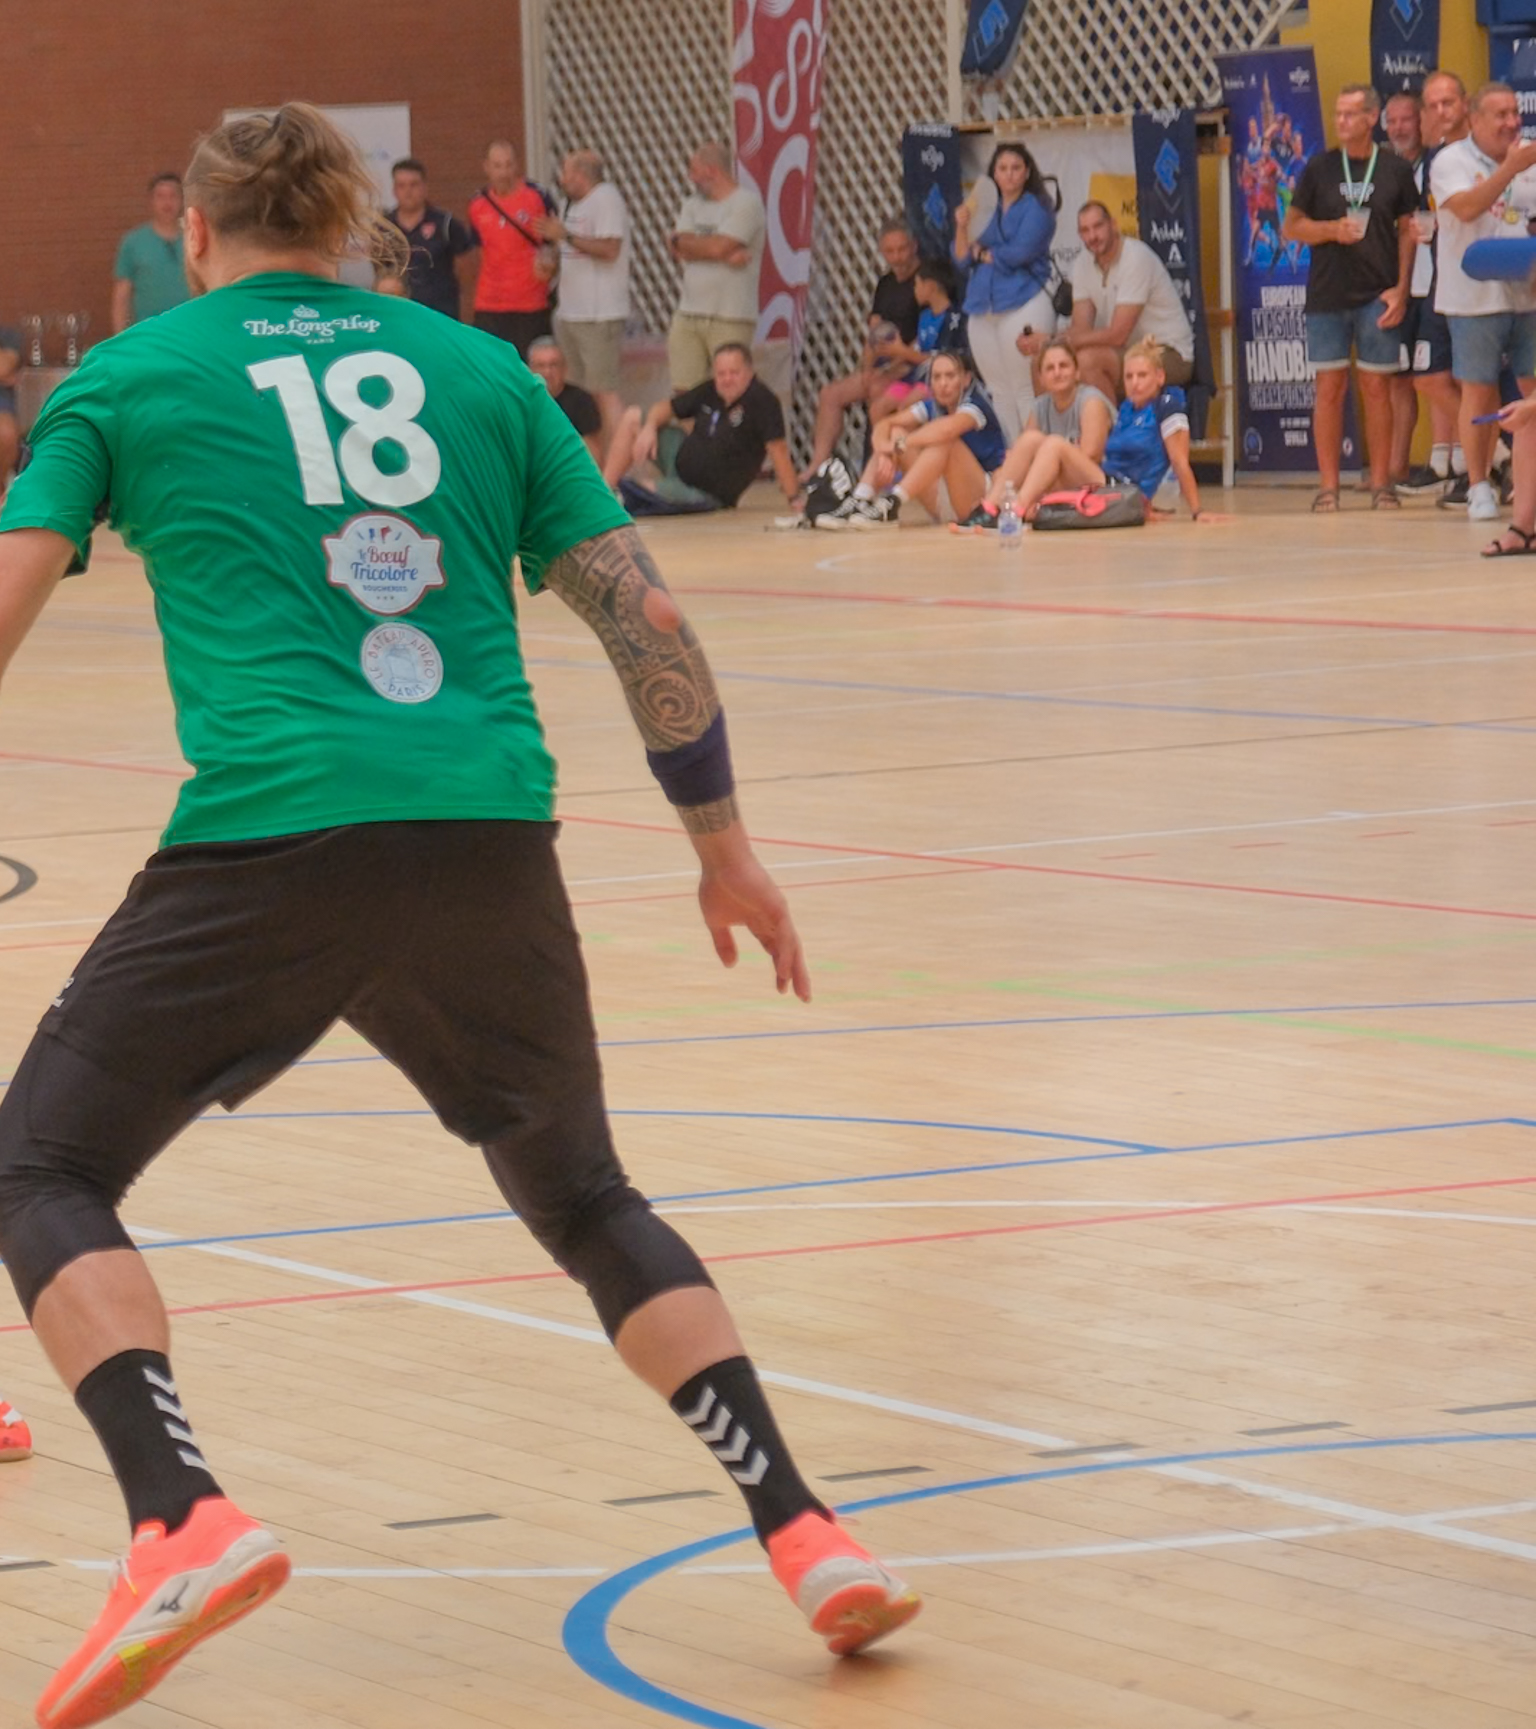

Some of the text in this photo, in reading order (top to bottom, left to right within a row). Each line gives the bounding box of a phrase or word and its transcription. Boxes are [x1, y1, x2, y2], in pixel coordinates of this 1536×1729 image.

[243, 319, 285, 337] The
[286, 318, 335, 337] Long
[245, 350, 442, 508] 18
[350, 561, 419, 581] Tricolore
